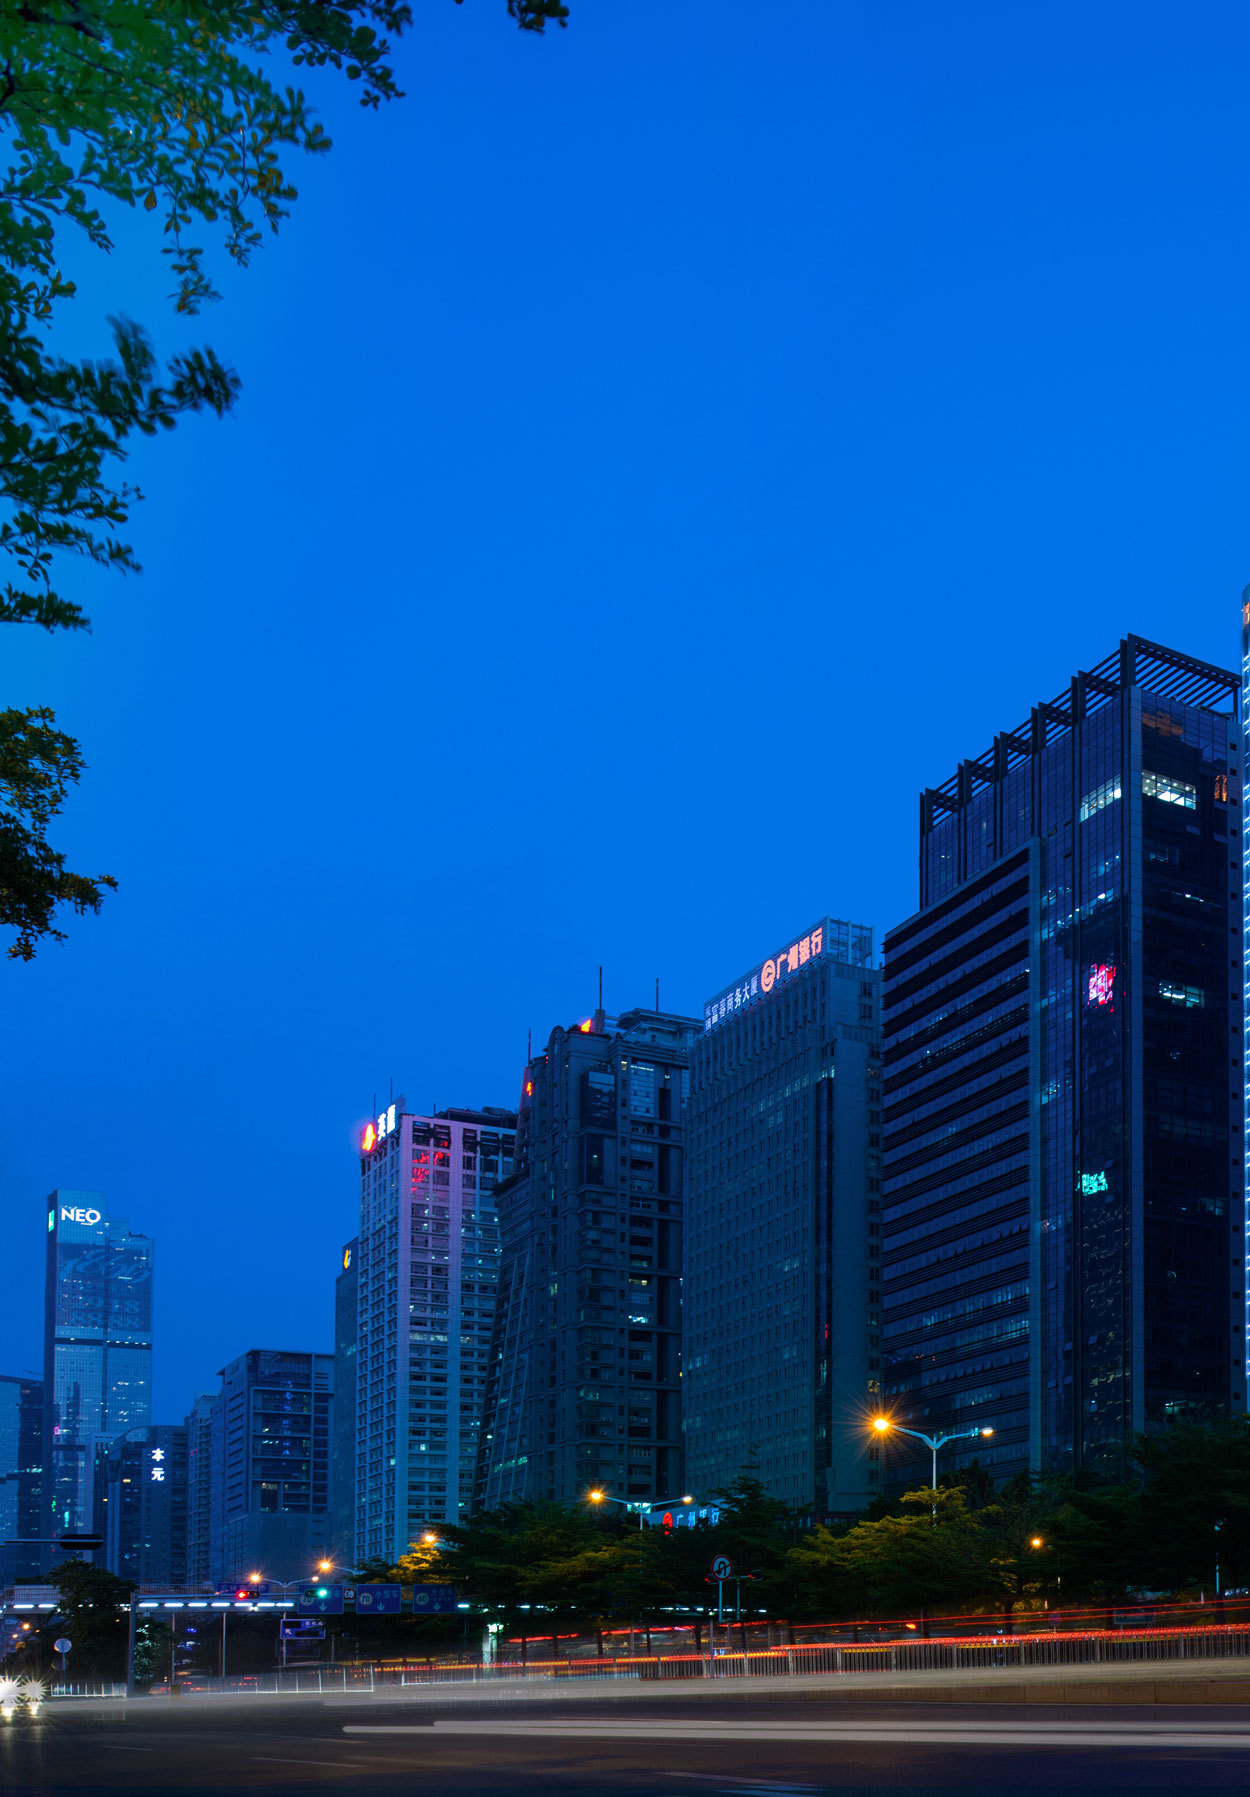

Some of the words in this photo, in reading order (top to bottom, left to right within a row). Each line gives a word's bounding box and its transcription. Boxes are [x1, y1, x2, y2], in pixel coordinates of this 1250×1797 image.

[776, 927, 823, 980] 广州银行
[61, 1208, 101, 1223] NEO
[151, 1448, 165, 1481] 本元
[361, 1595, 371, 1603] 70
